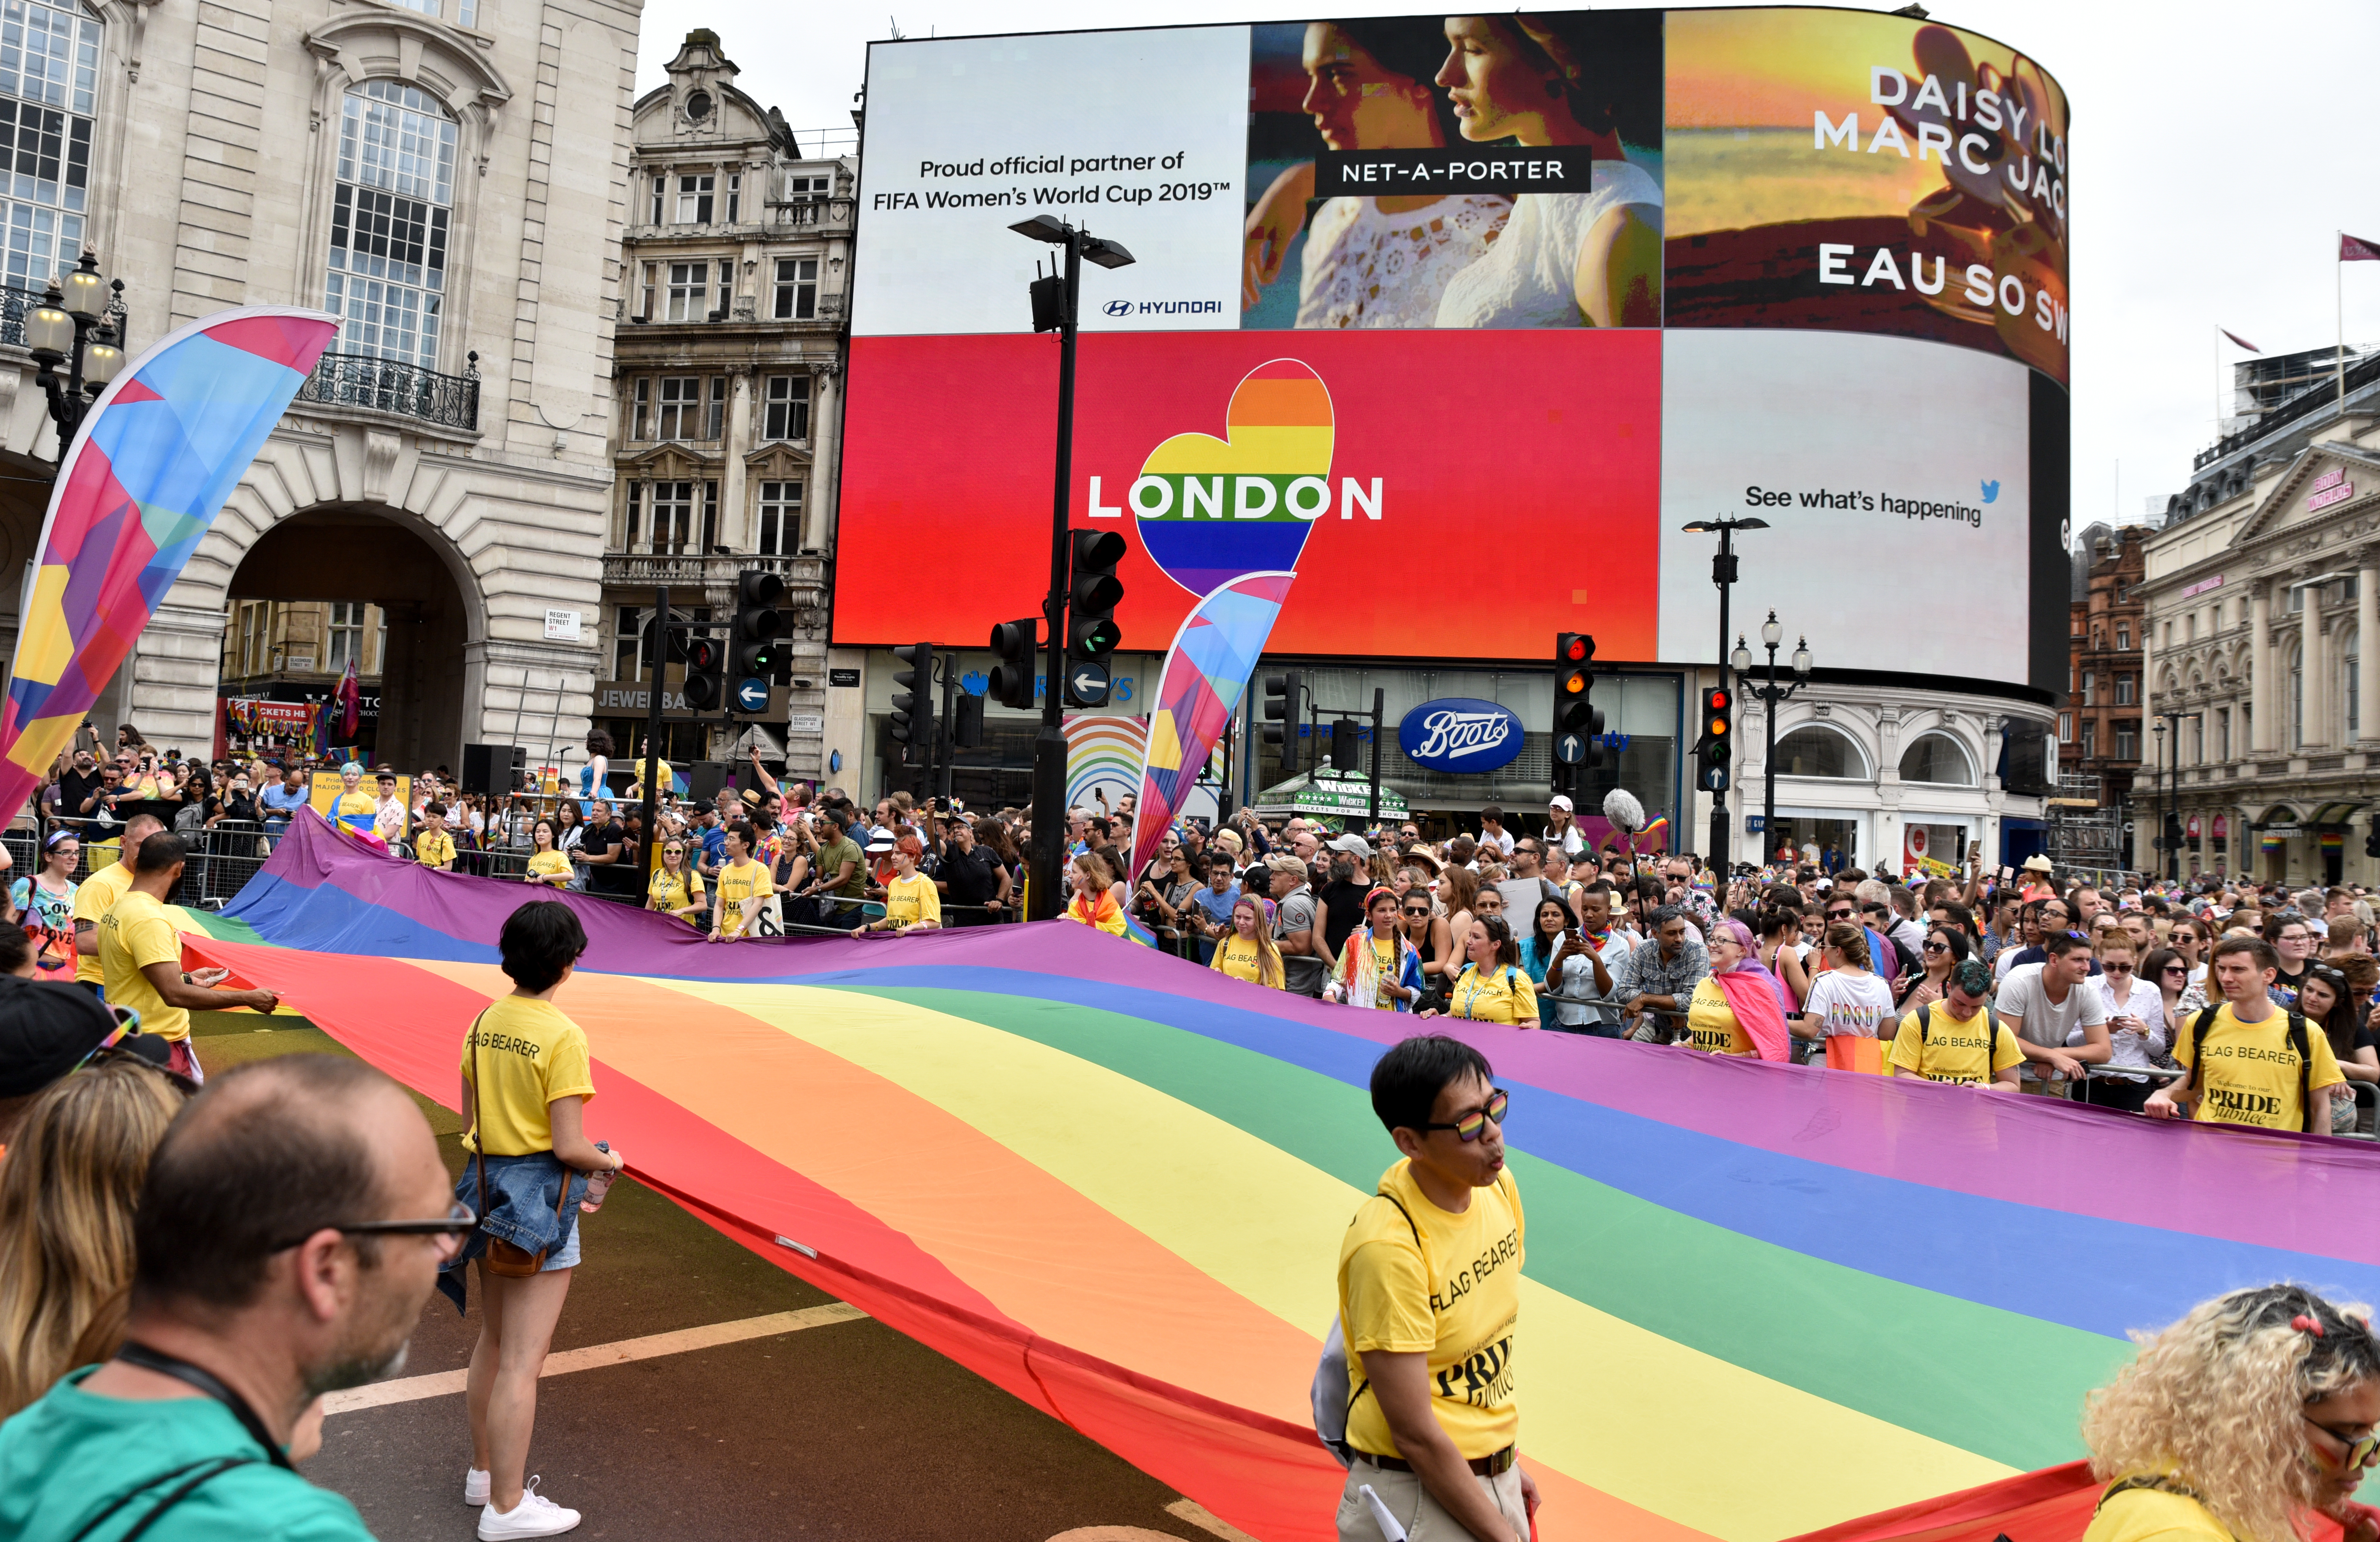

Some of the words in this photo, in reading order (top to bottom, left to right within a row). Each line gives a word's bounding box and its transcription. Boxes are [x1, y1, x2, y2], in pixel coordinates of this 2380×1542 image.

[1871, 66, 2027, 141] DAISY
[1815, 111, 1991, 175] MARC
[920, 158, 984, 178] Proud
[990, 154, 1063, 175] official
[1071, 154, 1155, 176] partner
[1161, 152, 1185, 169] of
[1343, 160, 1565, 182] NET-A-PORTER
[874, 192, 919, 210] FIFA
[1034, 185, 1099, 205] World
[1106, 184, 1152, 205] Cup
[1820, 243, 1945, 295] EAU
[1965, 264, 2025, 316] SO
[1140, 301, 1221, 314] HYUNDAI
[2313, 468, 2344, 494] BODY
[1088, 476, 1383, 520] LONDON
[1745, 486, 1792, 507] See
[1882, 493, 1981, 528] happening
[2306, 483, 2352, 512] WORLDS
[662, 692, 693, 710] BA
[1412, 711, 1508, 759] Boots
[1036, 754, 1039, 762] 1
[1754, 820, 1764, 828] GAP
[38, 903, 73, 918] LOV
[896, 895, 919, 903] BEARER
[39, 923, 73, 945] LOVE
[56, 918, 63, 927] is
[492, 1033, 540, 1060] BEARER
[1692, 1030, 1731, 1048] RIDE
[2200, 1046, 2233, 1057] FLAG
[2238, 1047, 2297, 1066] BEARER
[2217, 1079, 2247, 1090] Welcome
[2209, 1088, 2281, 1115] PRIDE
[2211, 1103, 2267, 1125] Jubilee
[1430, 1271, 1470, 1315] FLAG
[1463, 1330, 1496, 1358] Welcome
[1497, 1323, 1504, 1333] to
[1505, 1313, 1517, 1327] our
